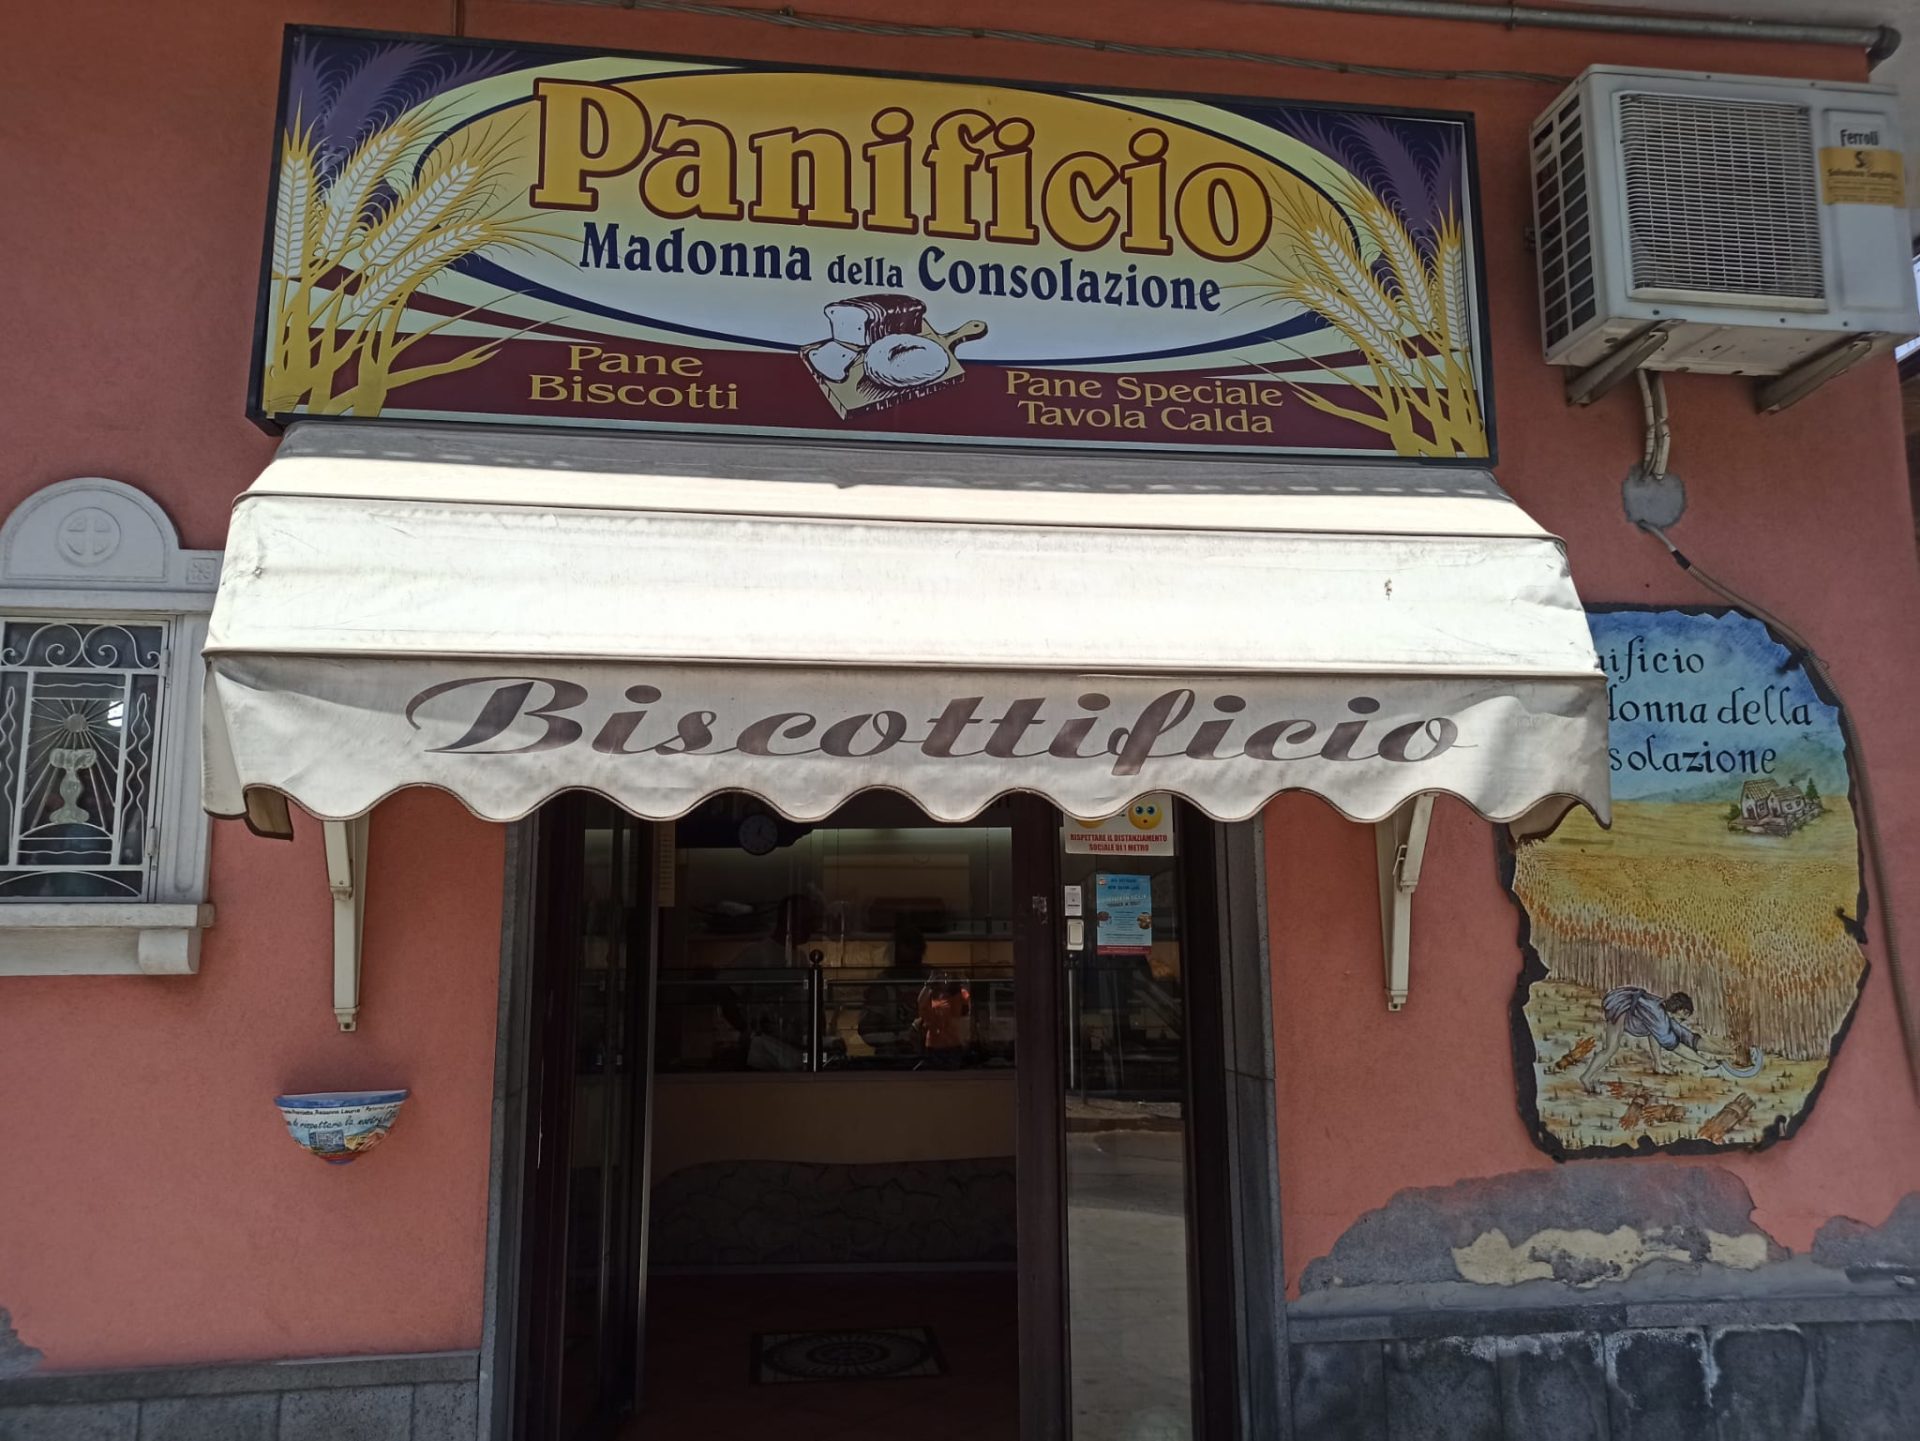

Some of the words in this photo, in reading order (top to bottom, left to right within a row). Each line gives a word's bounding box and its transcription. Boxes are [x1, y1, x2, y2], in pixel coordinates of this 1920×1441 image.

[1840, 129, 1880, 146] Ferroli
[529, 77, 1273, 263] Panificio
[580, 221, 812, 281] Madonna
[827, 254, 904, 289] della
[917, 247, 1222, 312] Consolazione
[568, 345, 703, 377] Pane
[528, 374, 739, 410] Biscotti
[1006, 370, 1102, 399] Pane
[1117, 376, 1284, 408] Speciale
[1017, 400, 1148, 429] Tavola
[1160, 407, 1275, 434] Calda
[1716, 685, 1813, 726] della
[405, 676, 1479, 776] Biscottificio
[1070, 833, 1106, 842] RISPETTARE
[1114, 834, 1168, 842] DISTANZIAMENTO
[1089, 843, 1114, 851] SOCIALE
[1127, 843, 1149, 852] METRO
